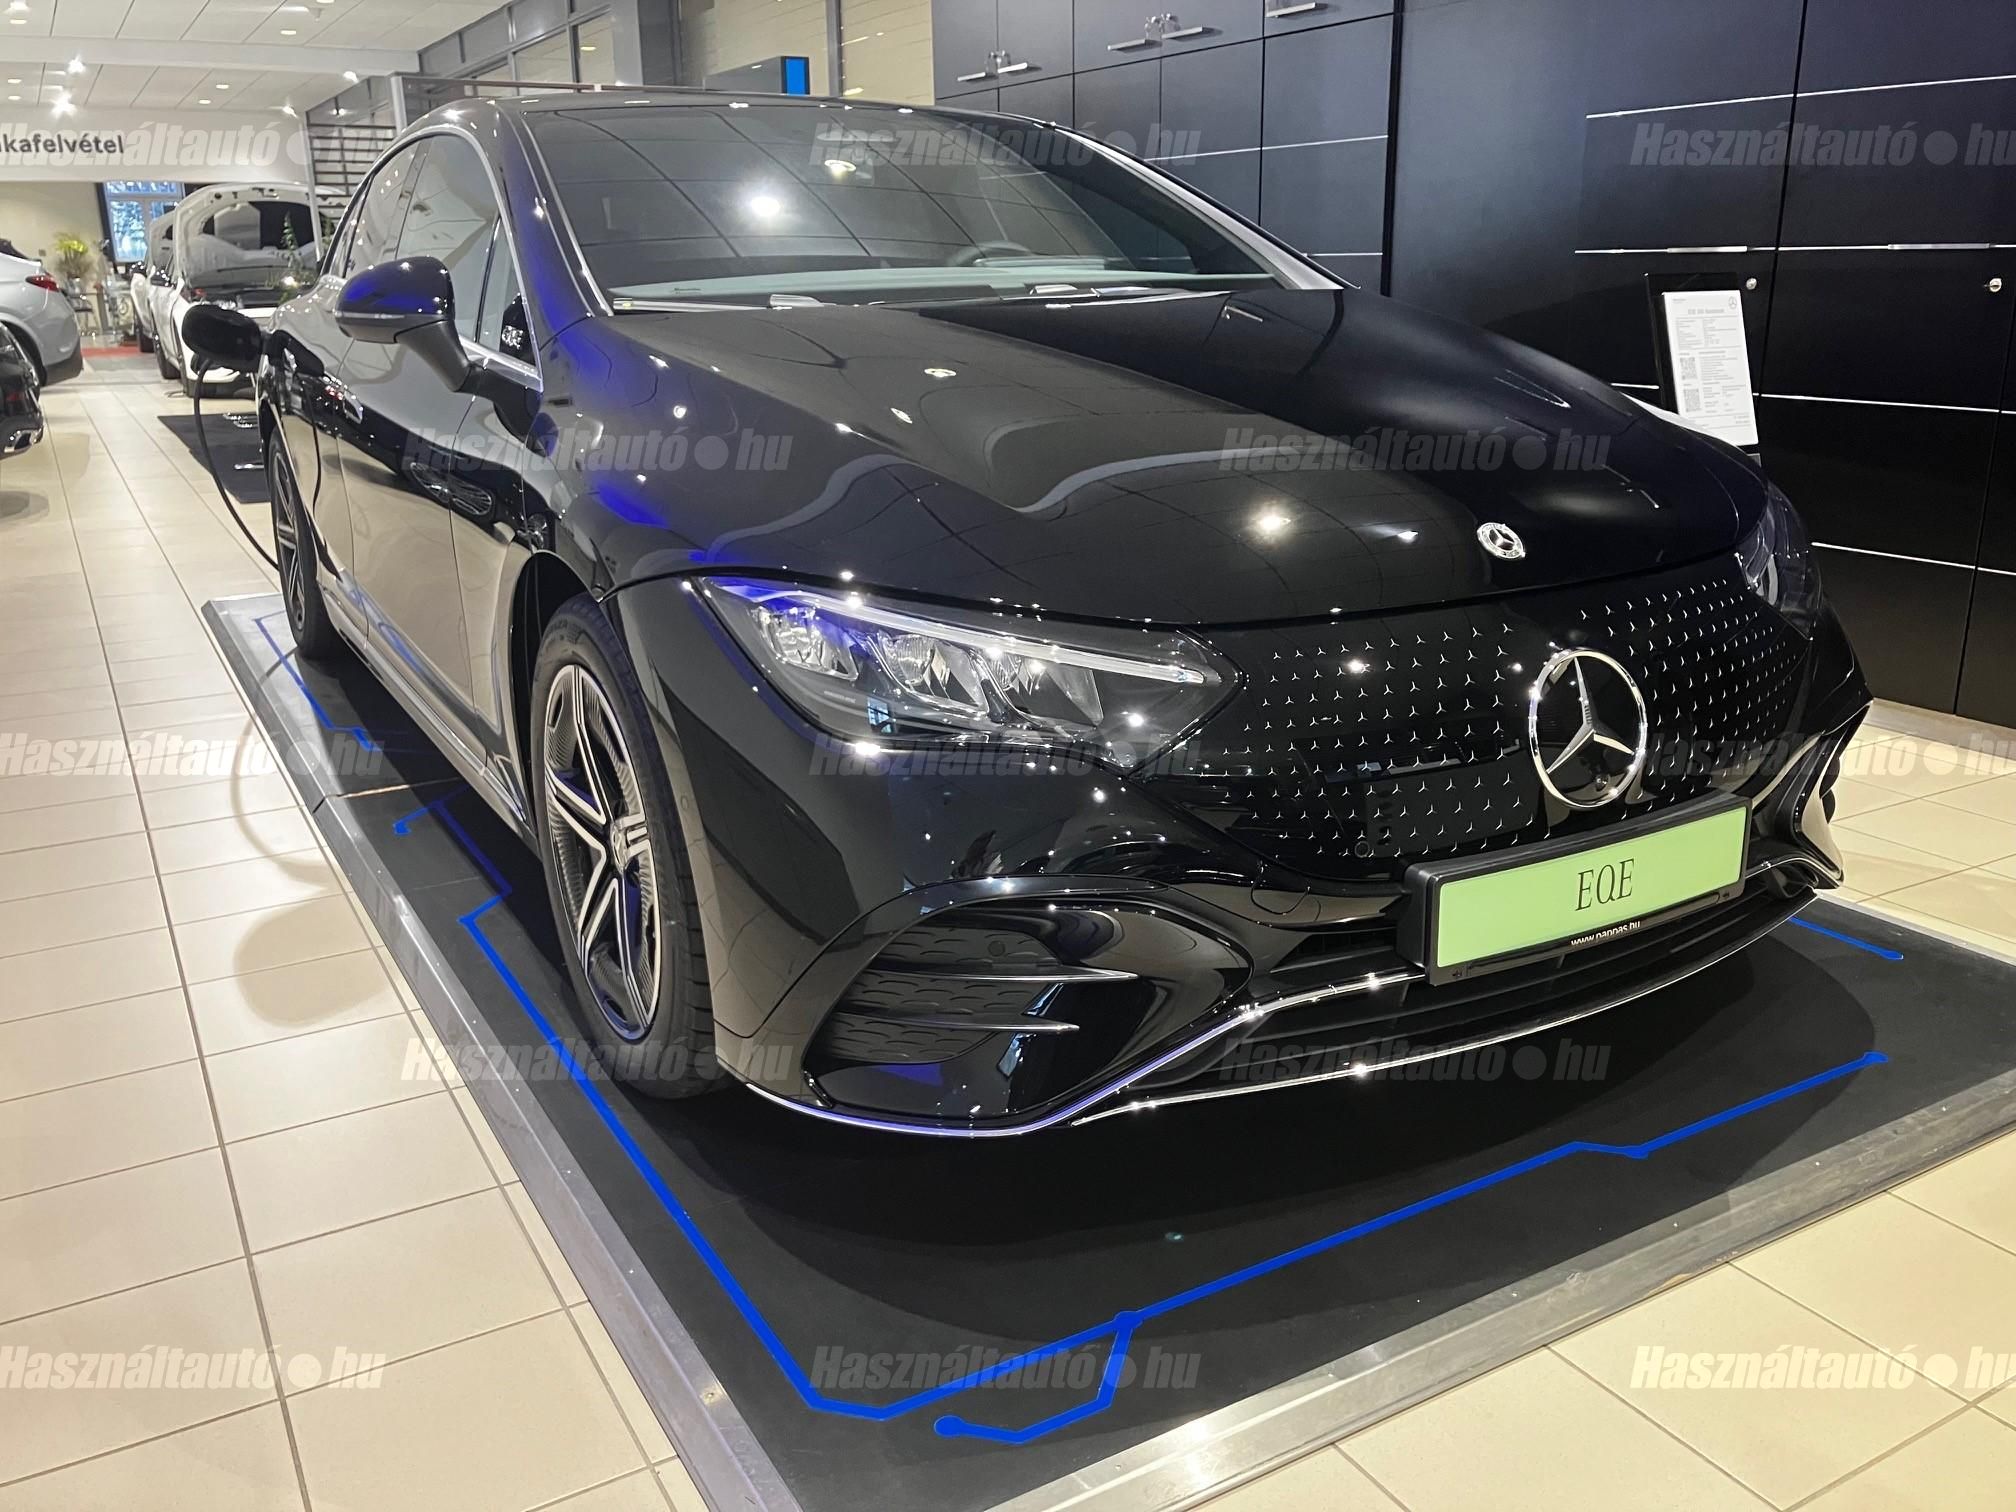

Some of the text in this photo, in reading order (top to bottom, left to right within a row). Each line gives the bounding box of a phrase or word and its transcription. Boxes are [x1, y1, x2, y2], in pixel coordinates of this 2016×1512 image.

[0, 133, 124, 153] kafelvétel
[1575, 858, 1635, 911] EQE
[1570, 920, 1641, 946] wwwpappashu
